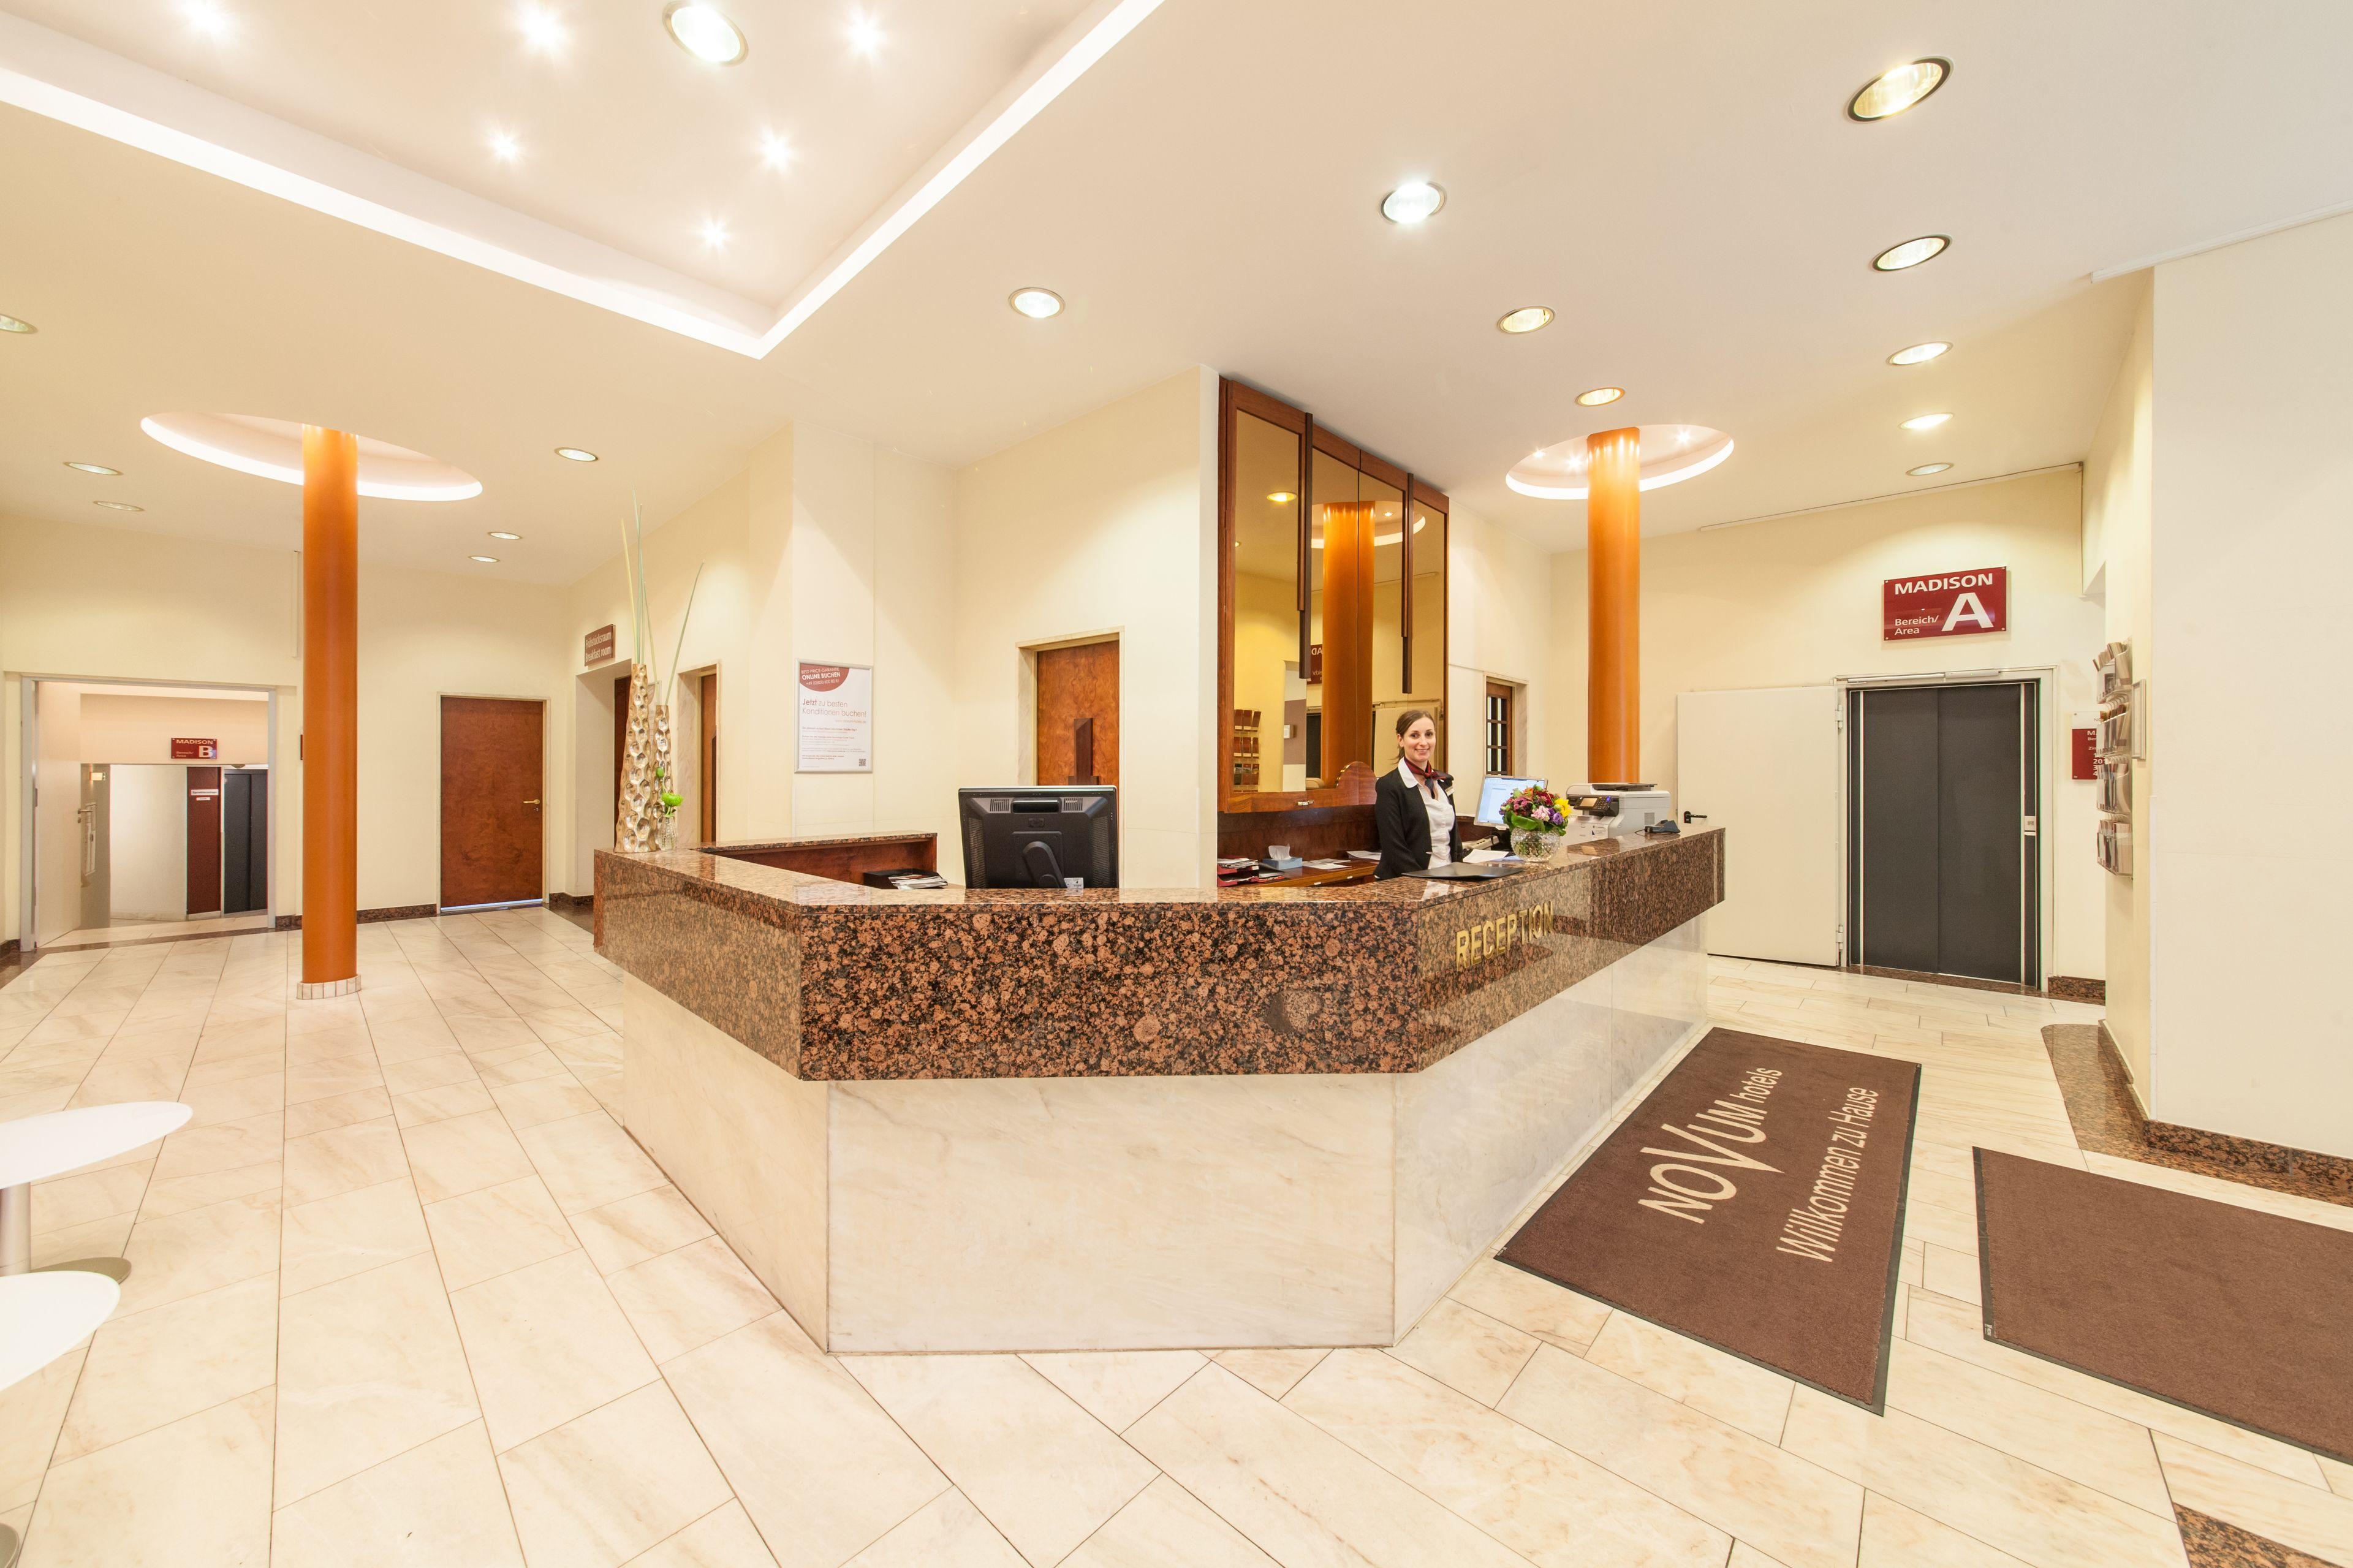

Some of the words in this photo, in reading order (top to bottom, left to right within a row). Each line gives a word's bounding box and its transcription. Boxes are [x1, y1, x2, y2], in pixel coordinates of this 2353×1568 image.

[1895, 573, 1993, 595] MADISON
[1895, 615, 1939, 626] Bereich/
[1941, 592, 1994, 632] A
[601, 646, 611, 657] room
[803, 707, 839, 716] Konditionen
[199, 745, 213, 757] B
[1456, 901, 1554, 972] RECEPTION
[1828, 1086, 1879, 1121] Hause
[1638, 1099, 1784, 1224] NOVUM
[1730, 1067, 1783, 1104] hotels
[1831, 1122, 1870, 1148] zu
[1776, 1145, 1862, 1262] Willkommen
